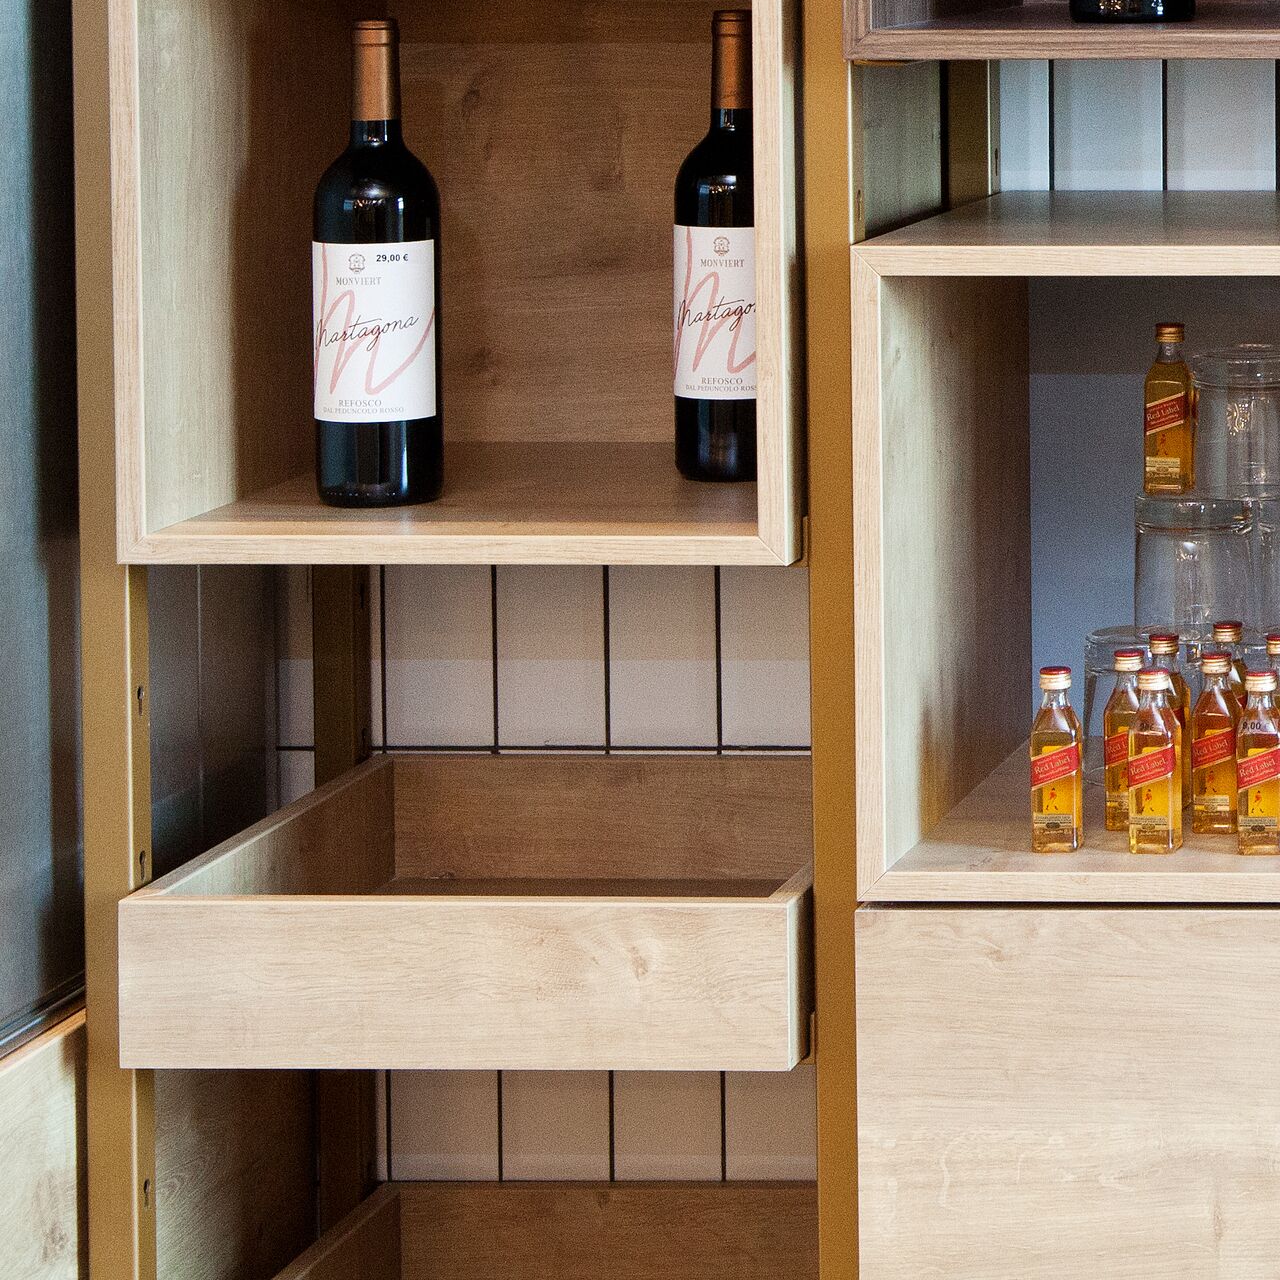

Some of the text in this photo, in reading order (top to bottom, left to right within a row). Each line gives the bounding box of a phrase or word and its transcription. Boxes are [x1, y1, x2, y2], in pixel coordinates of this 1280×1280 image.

[375, 253, 409, 263] 29,00 €
[700, 258, 745, 268] MONVIERT
[335, 276, 383, 286] MONVIERT
[677, 295, 756, 332] Martago
[314, 314, 420, 352] Martagona
[701, 377, 743, 385] REFOSCO
[338, 399, 383, 407] REFOSCO
[334, 407, 379, 415] PEDUNCOLO
[1050, 757, 1071, 770] Label
[1145, 758, 1167, 771] Label
[1256, 758, 1276, 772] Label
